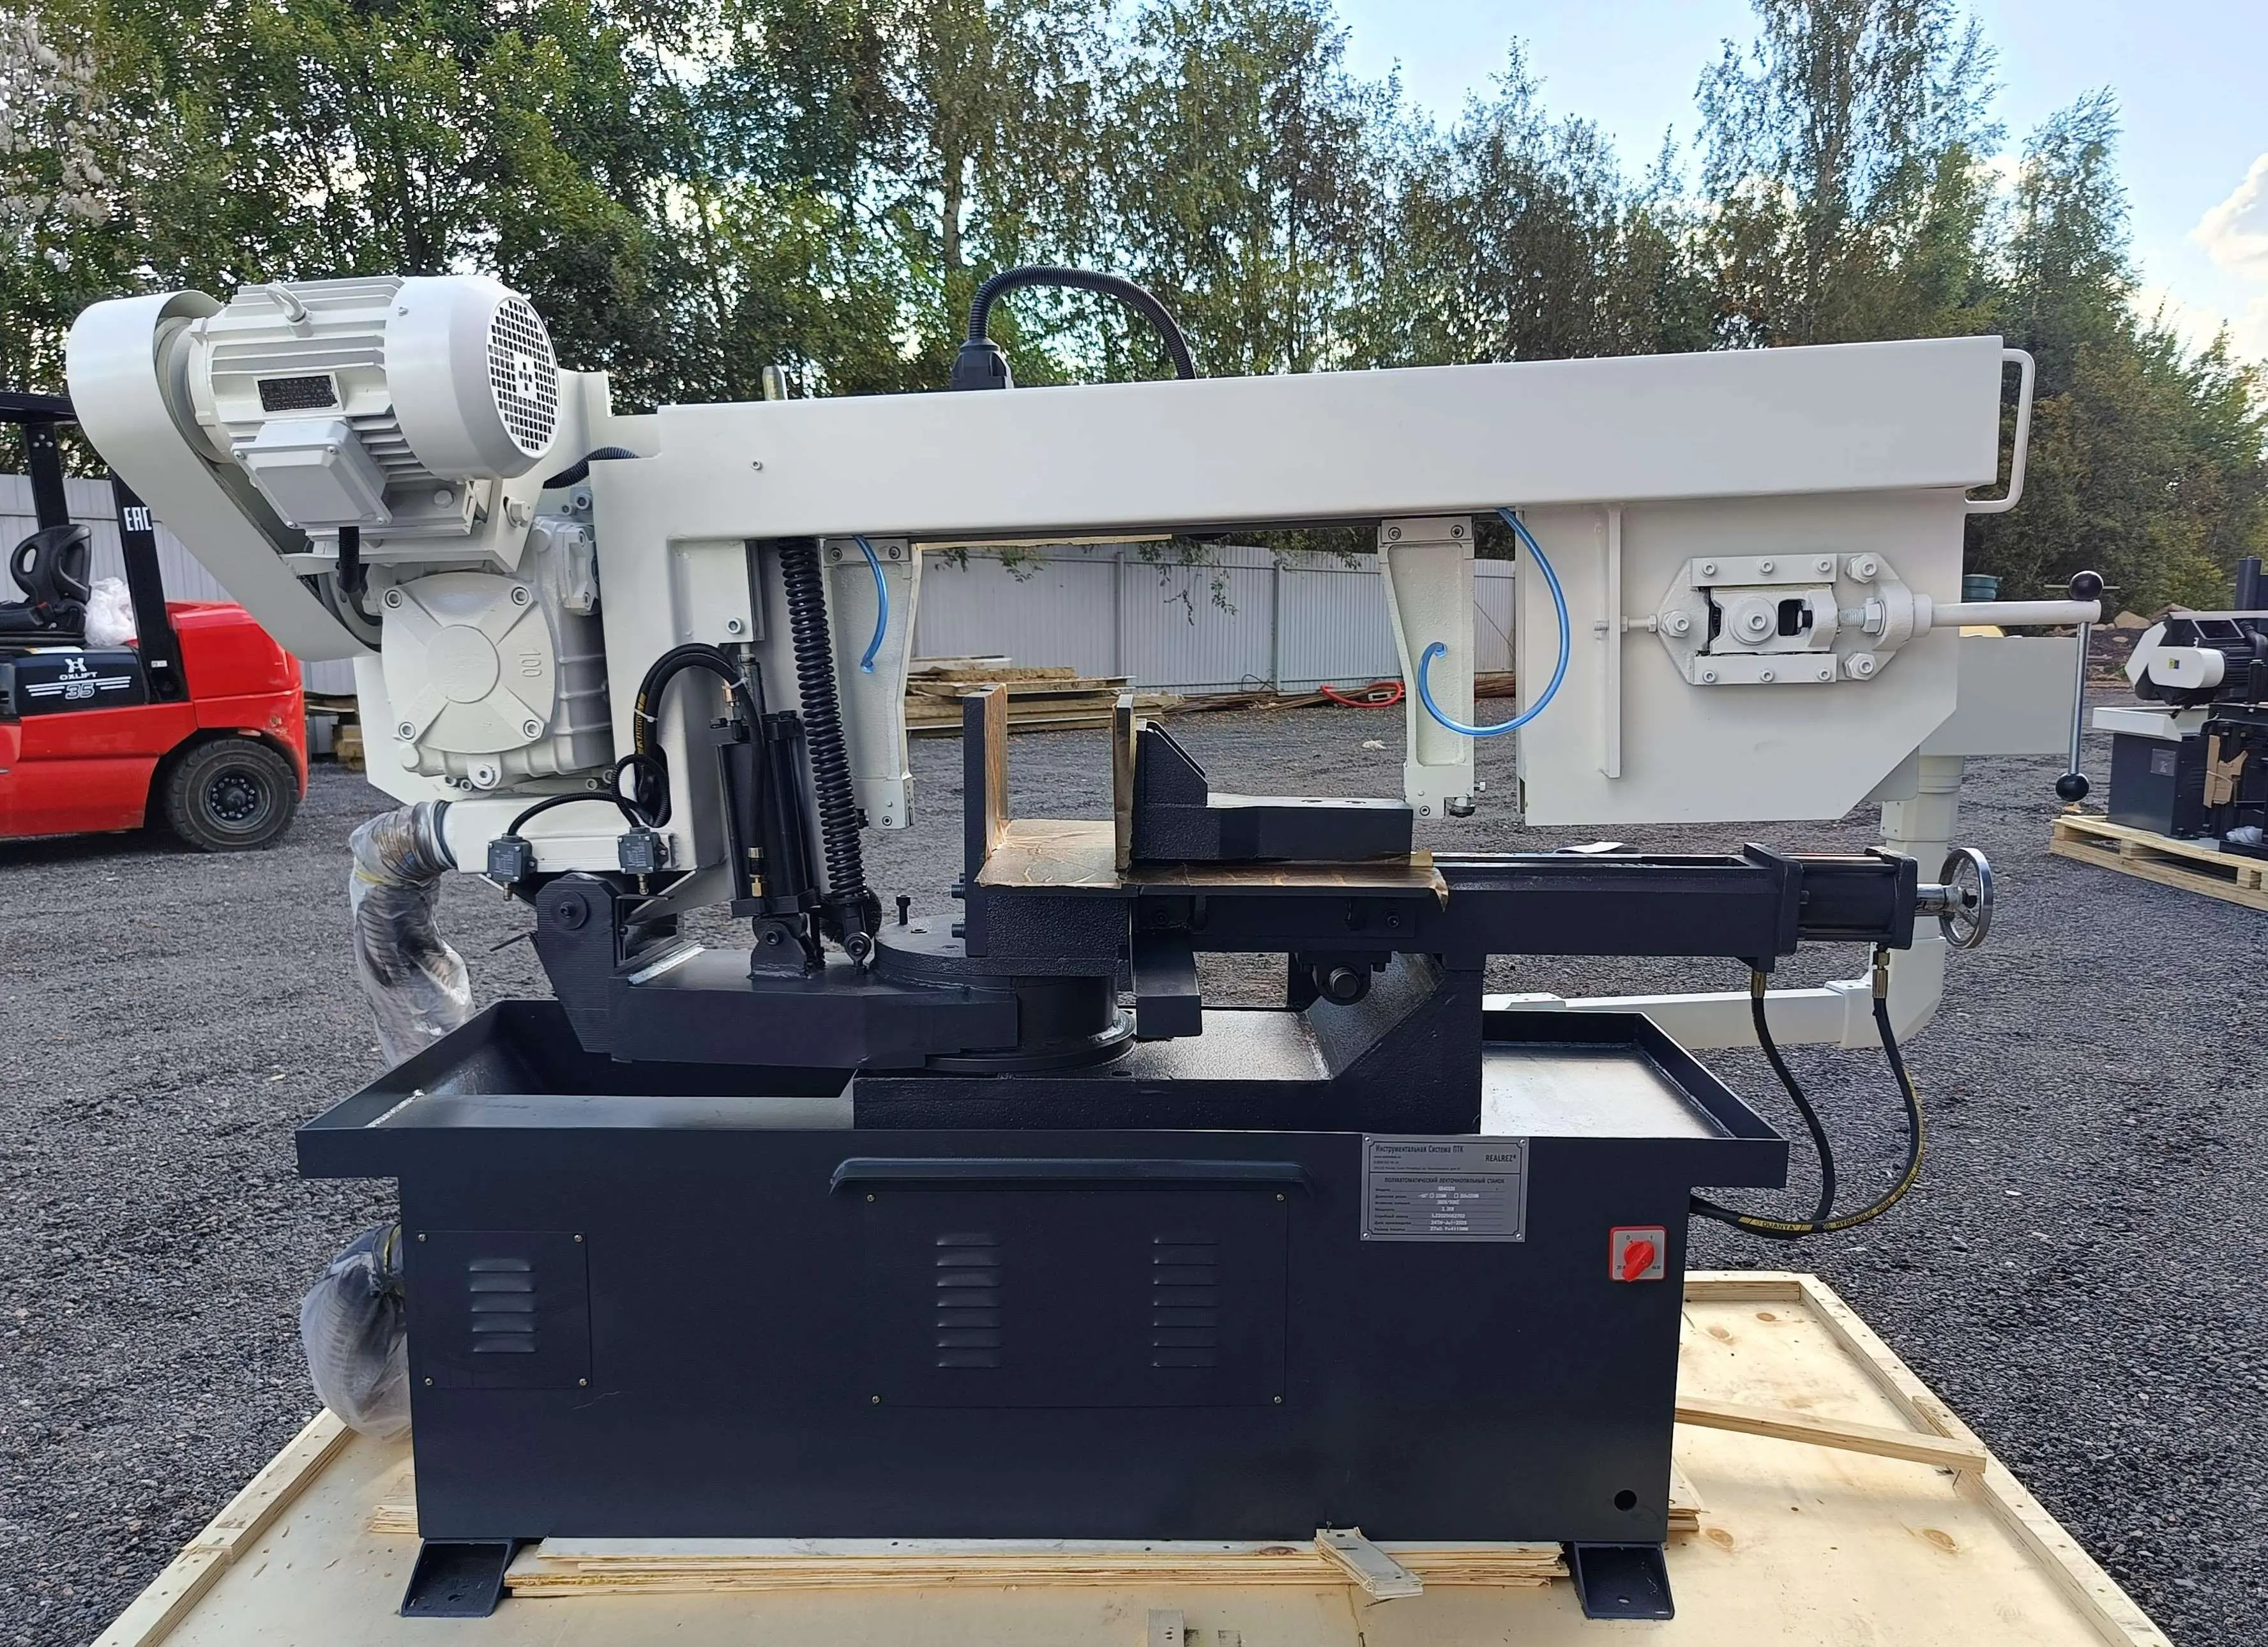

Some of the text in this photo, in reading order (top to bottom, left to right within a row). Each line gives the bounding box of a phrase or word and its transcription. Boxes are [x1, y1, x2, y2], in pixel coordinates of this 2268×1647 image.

[123, 506, 153, 531] EAC
[519, 648, 542, 678] 100
[59, 671, 98, 681] OXLIFT
[64, 683, 95, 700] 35
[1375, 1144, 1464, 1154] Инструментальная Система ПТК
[1836, 1210, 1875, 1227] HYDRAULIC
